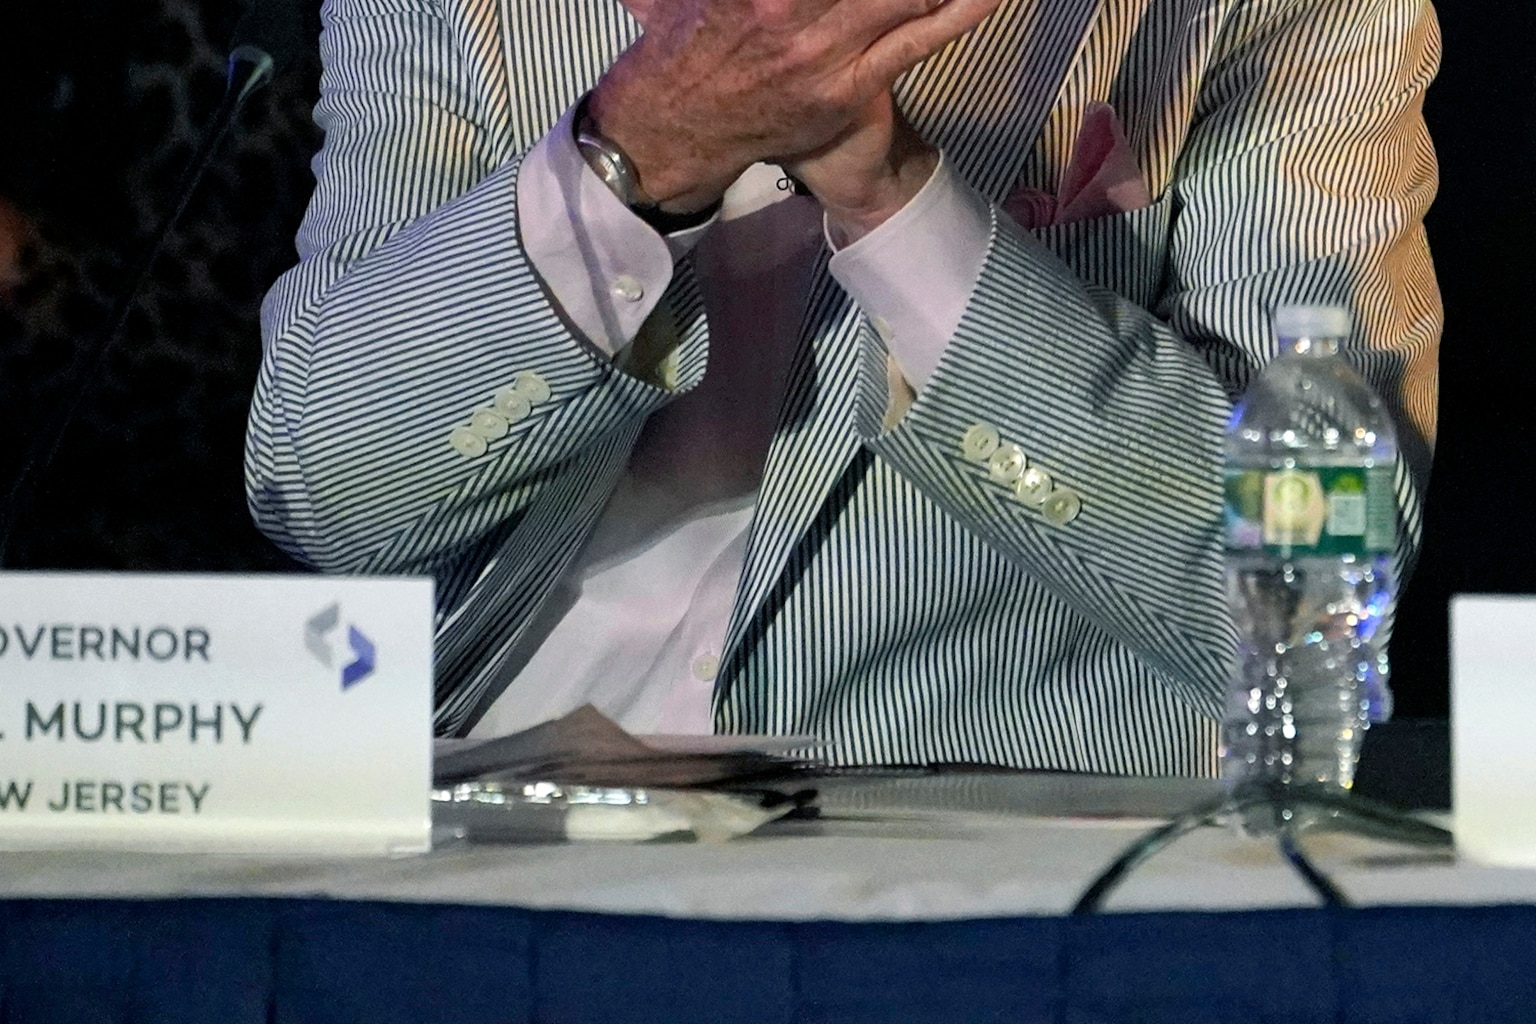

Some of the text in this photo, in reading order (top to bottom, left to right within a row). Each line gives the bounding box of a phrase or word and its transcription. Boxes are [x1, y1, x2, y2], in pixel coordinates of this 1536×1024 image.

[0, 624, 212, 662] VERNOR
[23, 698, 265, 745] MURPHY
[47, 779, 211, 815] JERSEY
